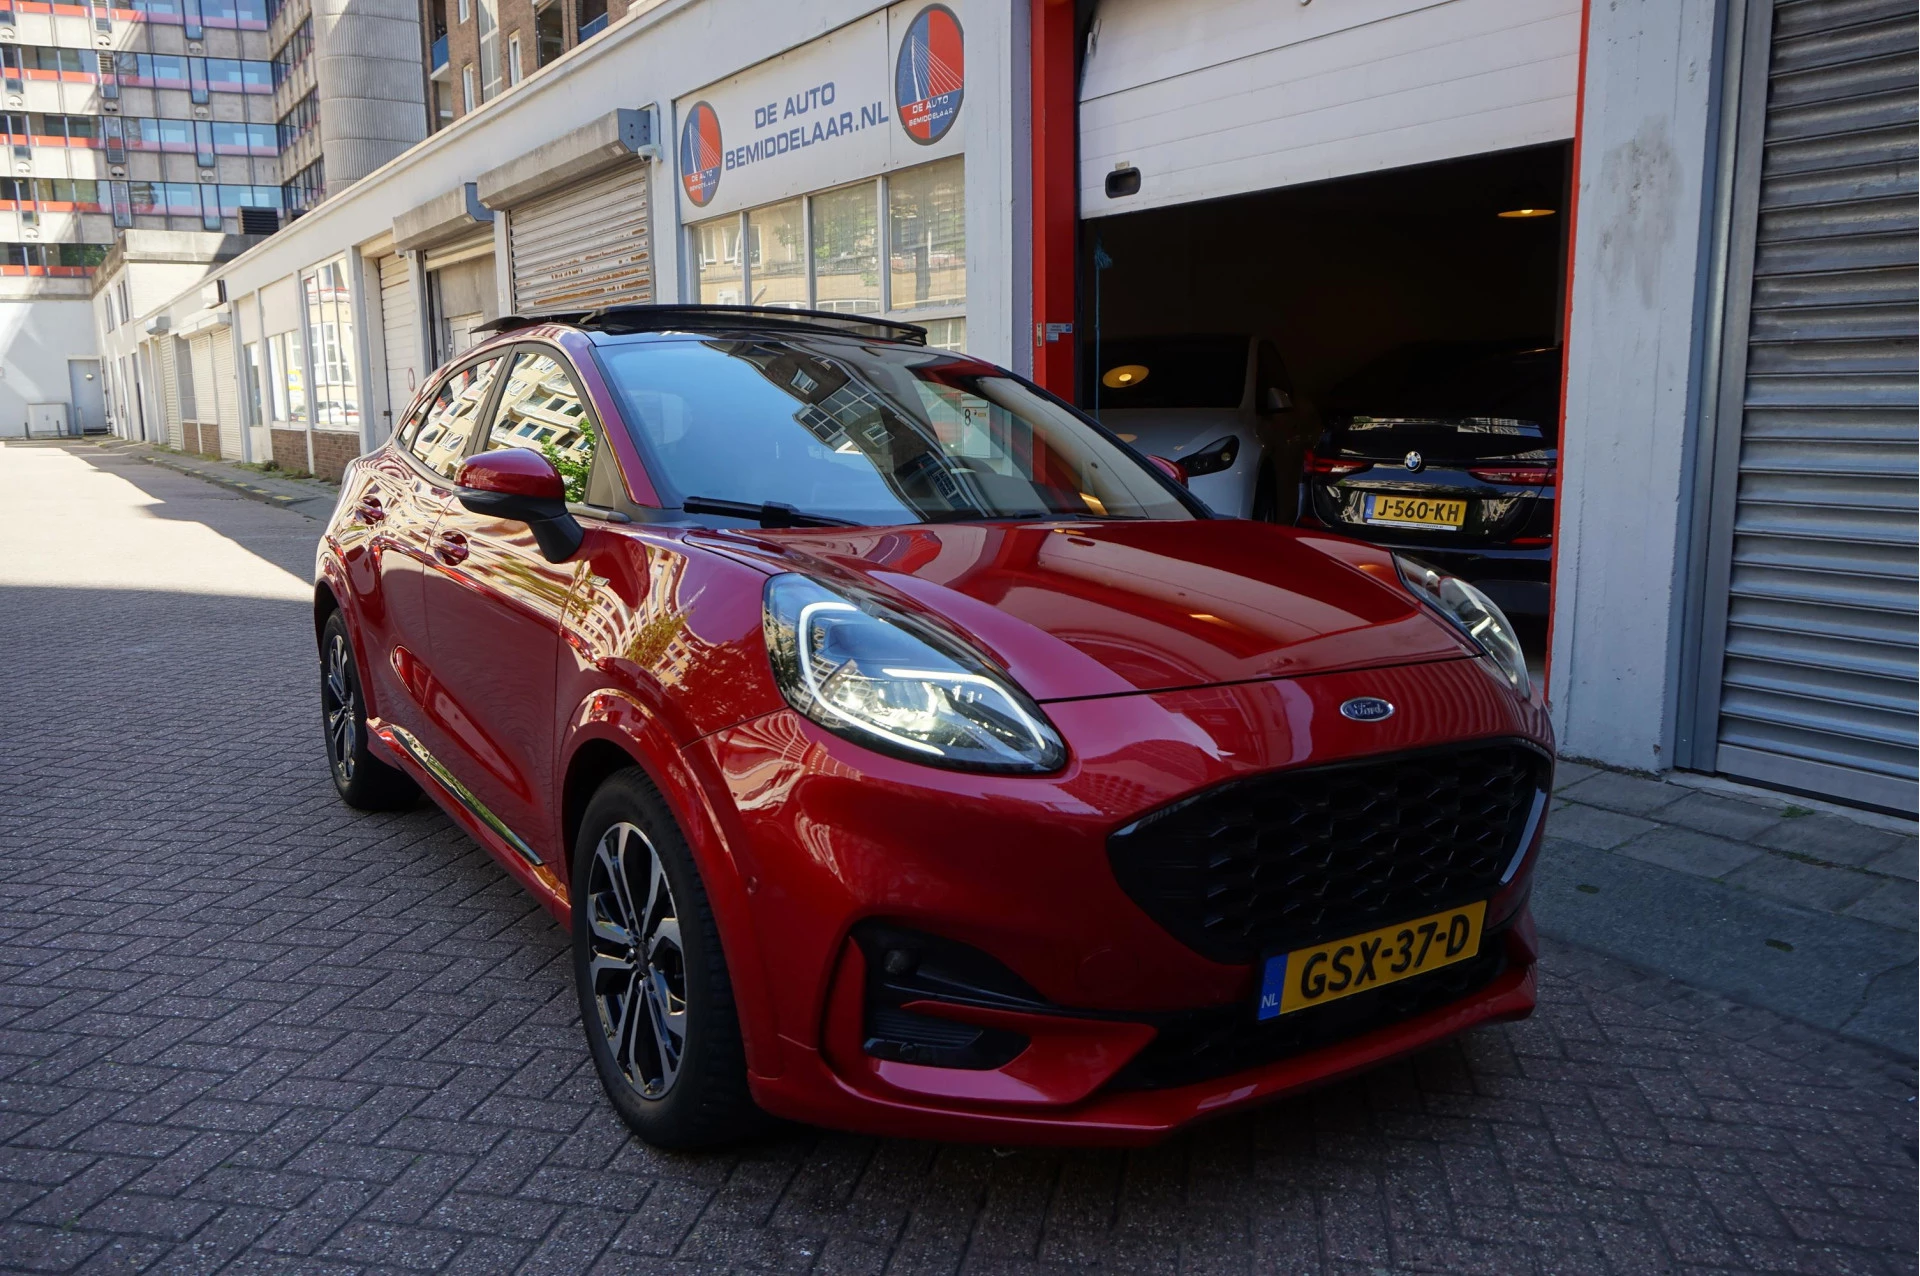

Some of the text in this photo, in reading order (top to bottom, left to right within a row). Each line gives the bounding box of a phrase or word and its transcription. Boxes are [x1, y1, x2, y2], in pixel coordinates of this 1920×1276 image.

[755, 82, 835, 129] DE AUTO
[912, 95, 949, 114] DE AUTO
[725, 101, 889, 171] BEMIDDELAAR.NL
[964, 408, 971, 427] 8
[1378, 499, 1459, 521] J-560-KH
[1353, 702, 1384, 716] Ford
[1301, 914, 1470, 999] GSX-37-D
[1261, 993, 1279, 1009] NL
